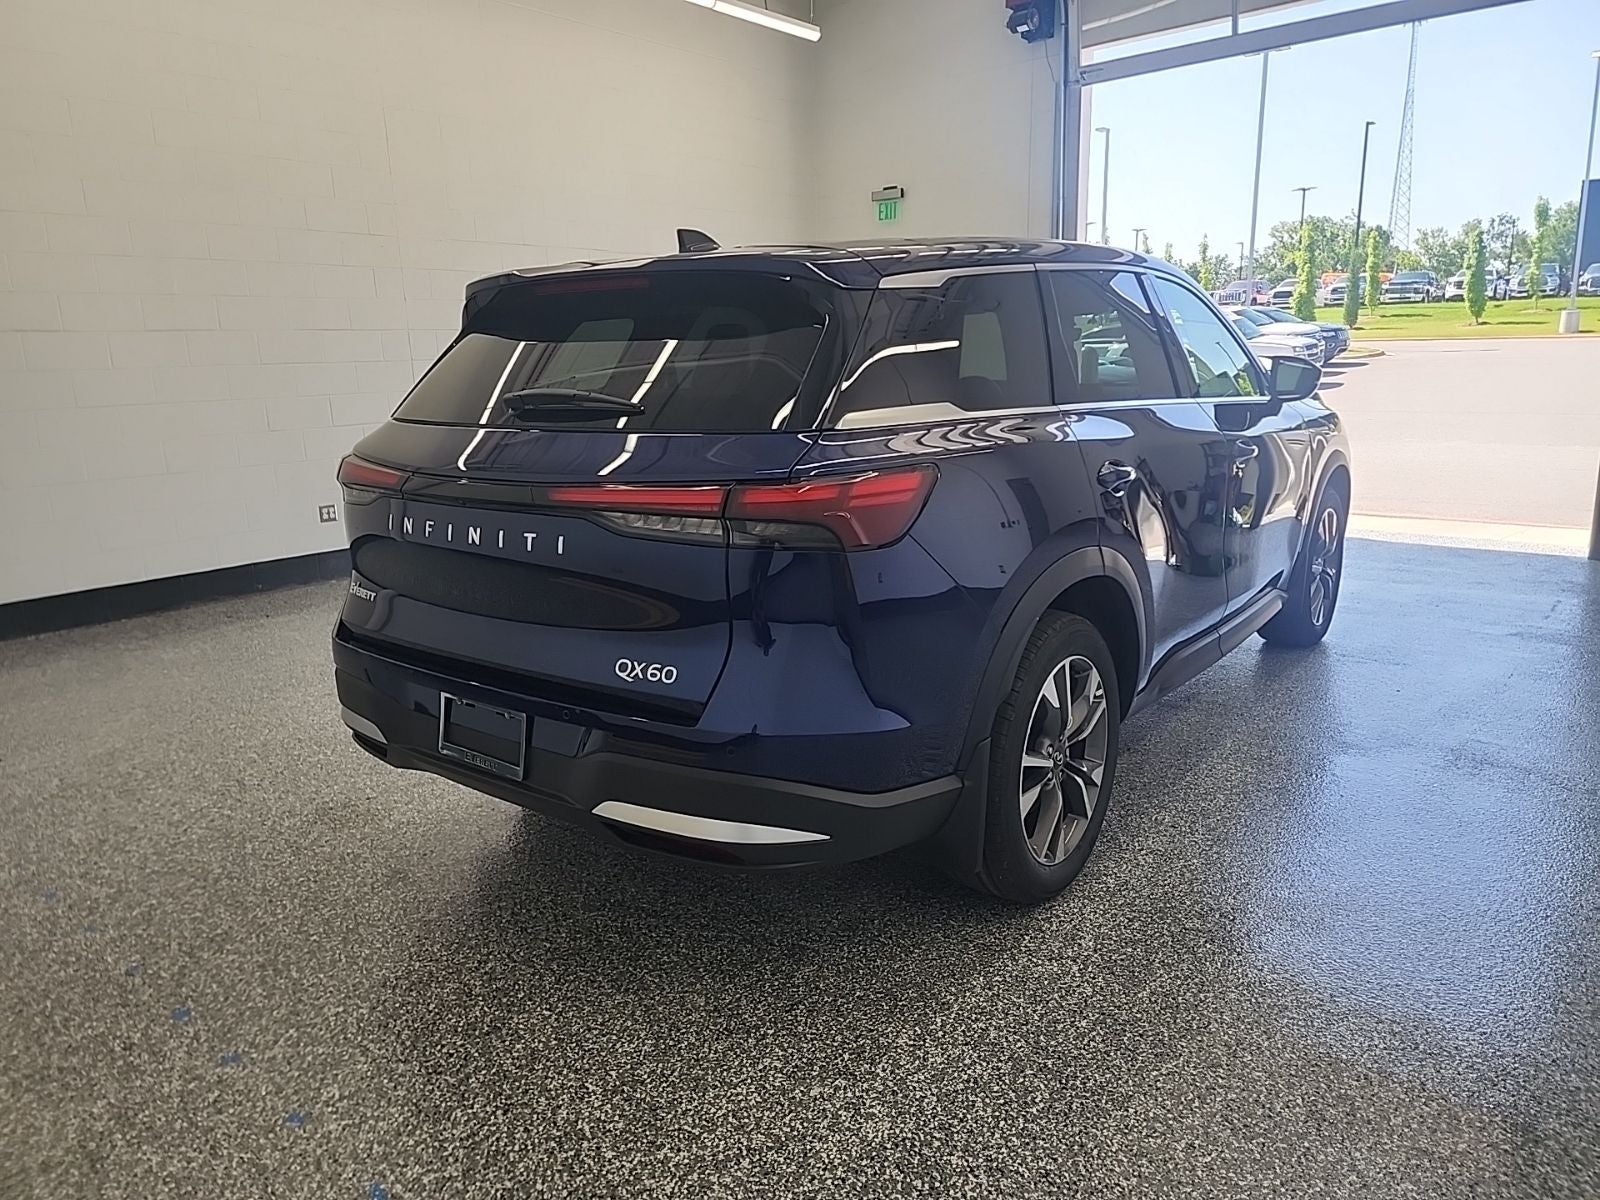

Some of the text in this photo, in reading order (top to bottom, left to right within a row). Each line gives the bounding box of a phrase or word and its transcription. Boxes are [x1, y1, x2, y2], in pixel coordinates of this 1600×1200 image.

[878, 201, 898, 221] EXIT
[388, 513, 564, 555] INFINITI
[615, 658, 678, 684] QX60
